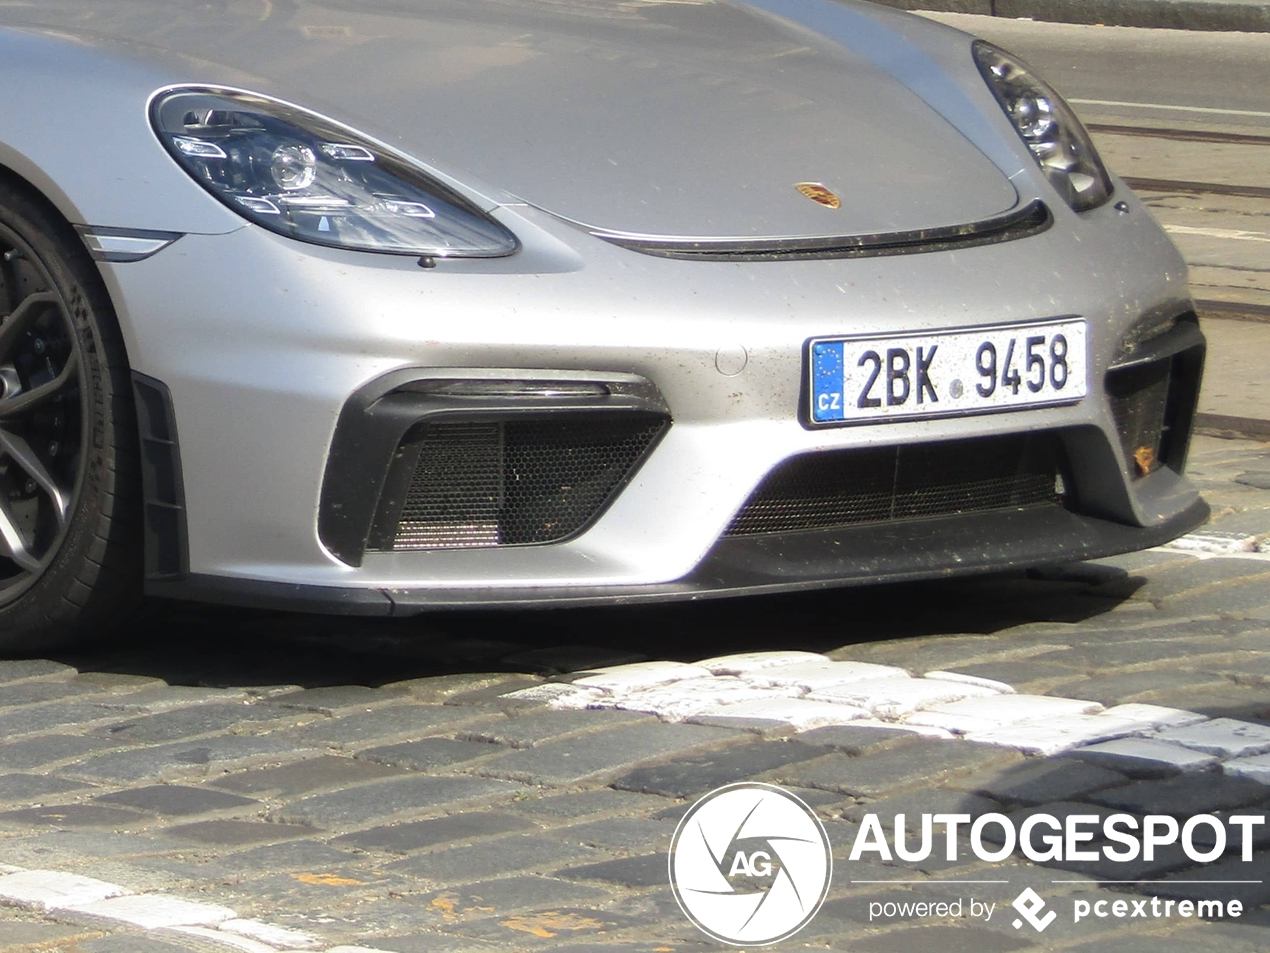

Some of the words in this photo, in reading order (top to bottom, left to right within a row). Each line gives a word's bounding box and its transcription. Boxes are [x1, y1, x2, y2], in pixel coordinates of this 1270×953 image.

[856, 344, 939, 408] 2BK
[975, 333, 1068, 398] 9458
[818, 392, 840, 411] CZ
